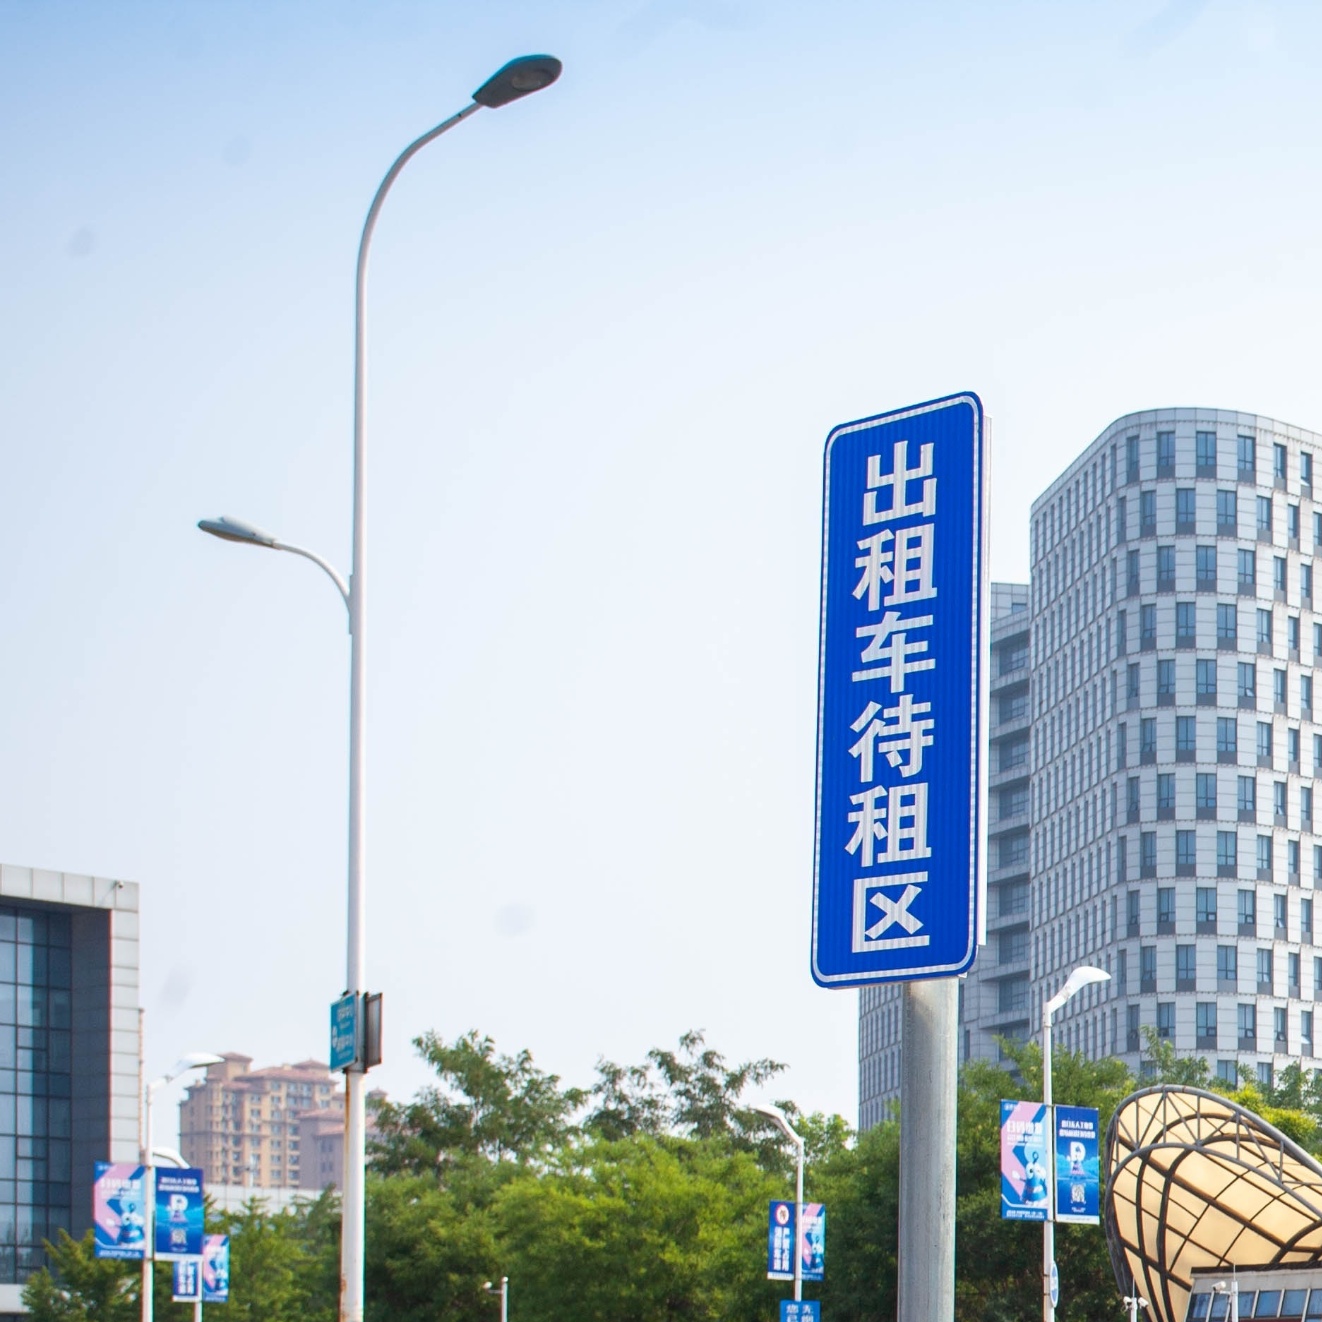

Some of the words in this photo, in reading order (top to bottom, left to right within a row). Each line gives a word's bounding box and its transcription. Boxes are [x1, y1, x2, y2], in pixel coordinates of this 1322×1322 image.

[844, 440, 938, 954] 出租车待租区
